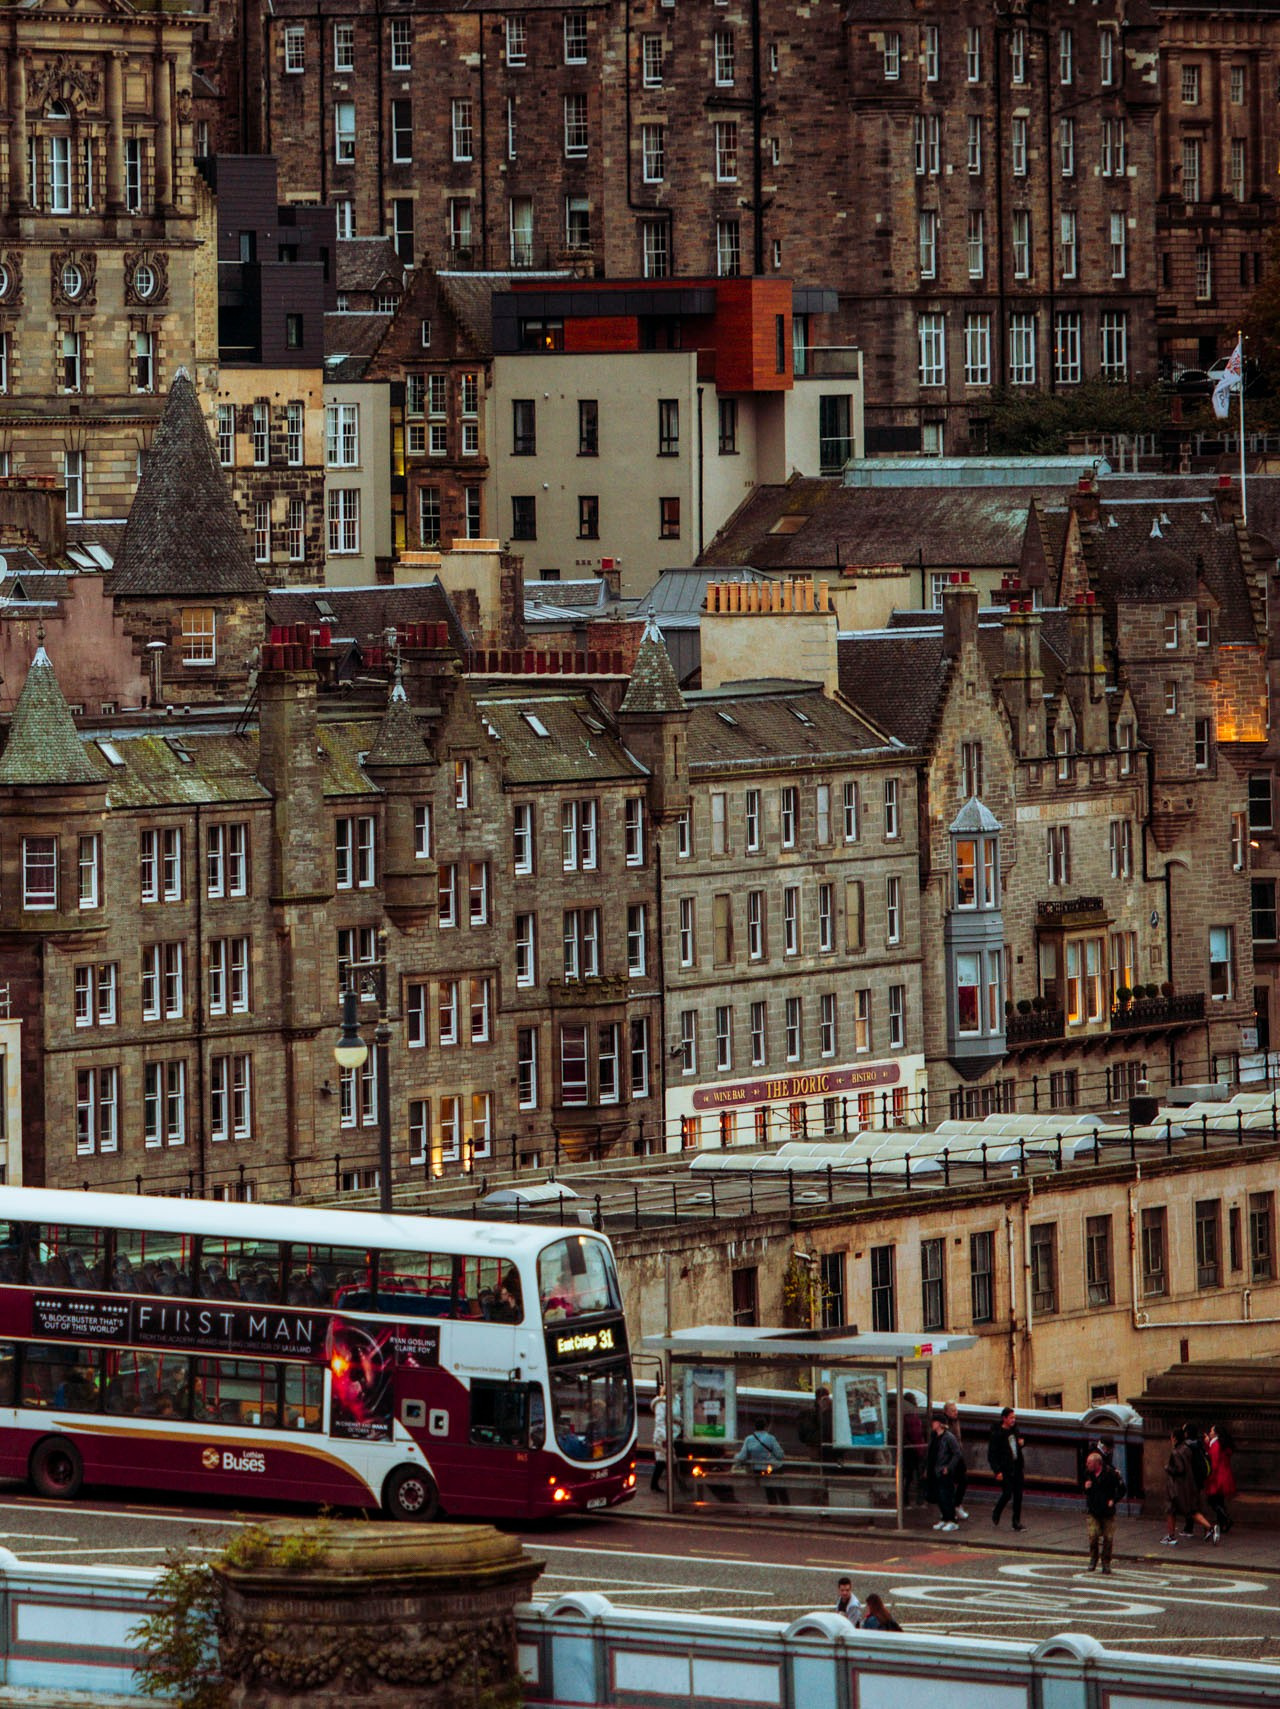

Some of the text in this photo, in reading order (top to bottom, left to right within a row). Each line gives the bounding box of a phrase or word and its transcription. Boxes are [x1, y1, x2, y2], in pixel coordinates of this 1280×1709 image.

[713, 1071, 877, 1102] WINE BAR THE DORIC BISTRO
[44, 1321, 59, 1329] OUT
[61, 1322, 71, 1330] OF
[71, 1323, 88, 1332] THIS
[48, 1313, 98, 1325] BLOCKBUSTER
[99, 1317, 124, 1327] THAT'S
[139, 1306, 313, 1343] FIRST MAN
[389, 1337, 436, 1347] RYAN GOSLING
[598, 1328, 614, 1349] 31
[394, 1345, 416, 1353] CLAIRE
[242, 1450, 265, 1459] Lothian
[222, 1452, 266, 1473] Buses
